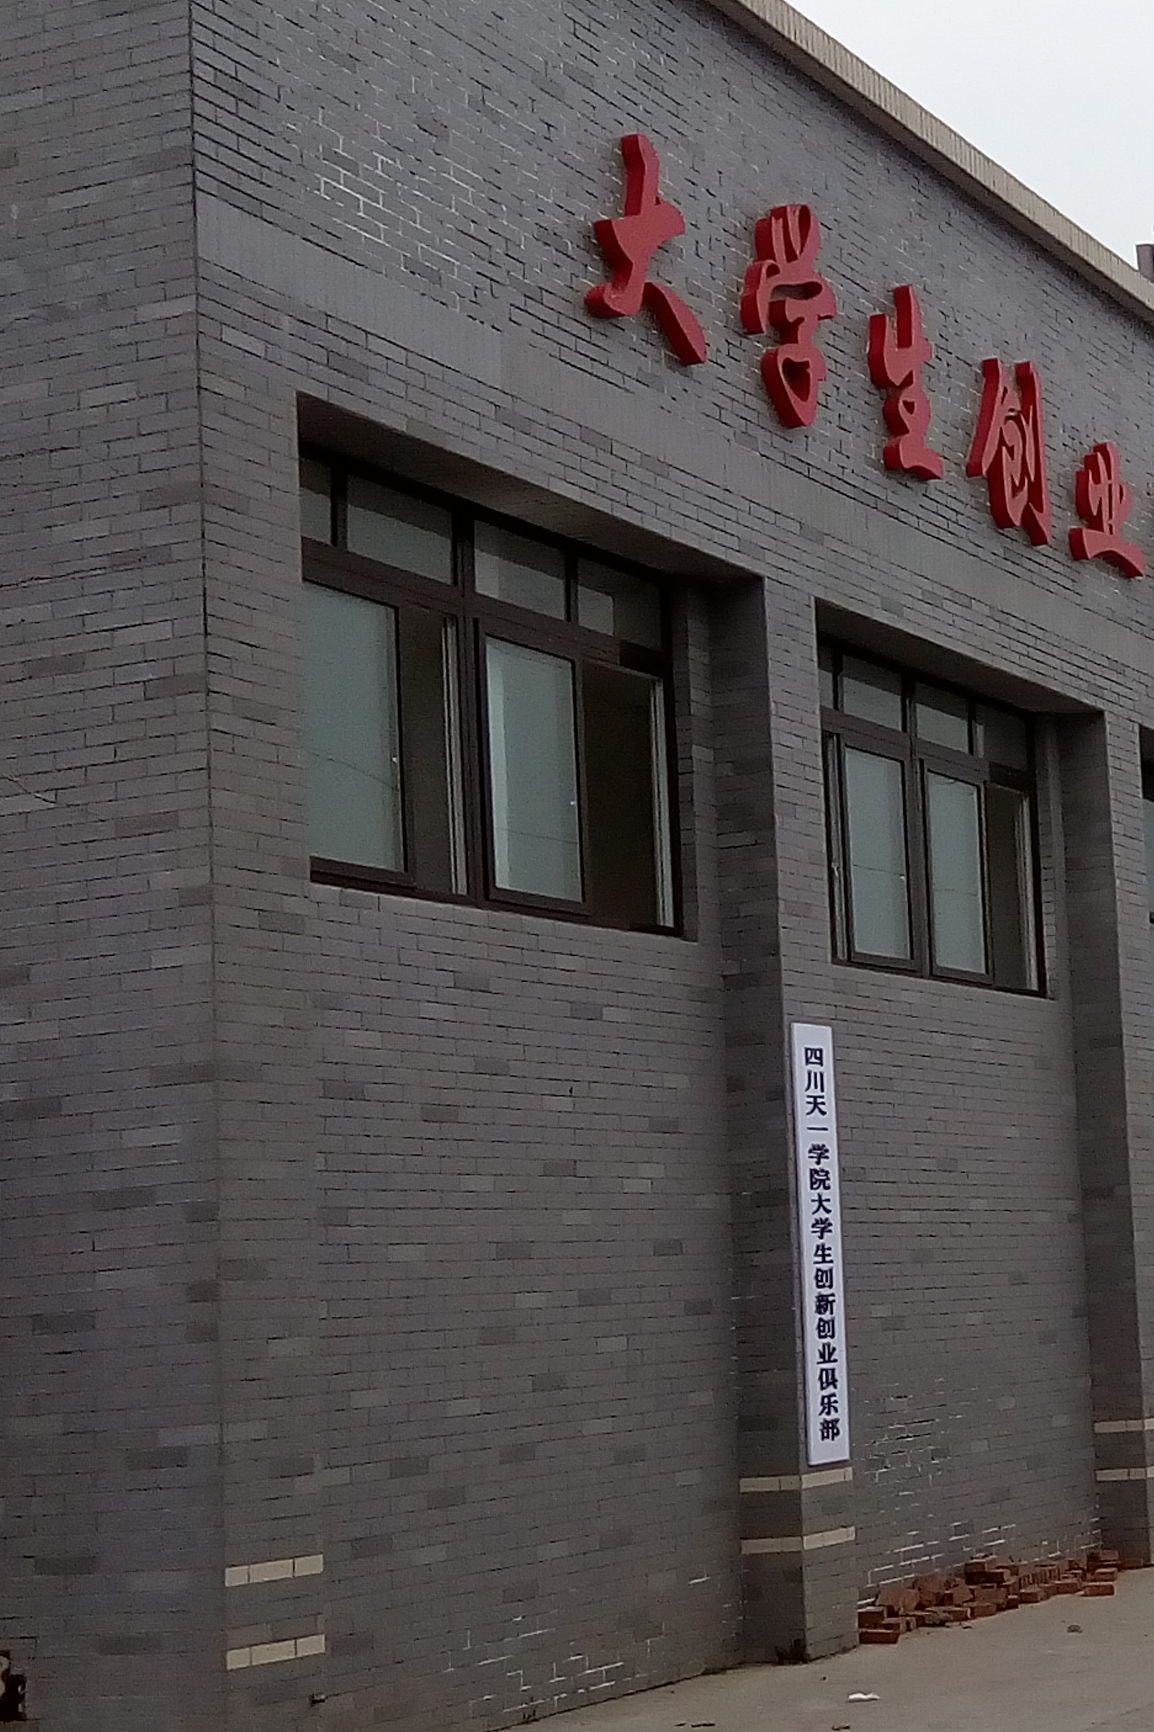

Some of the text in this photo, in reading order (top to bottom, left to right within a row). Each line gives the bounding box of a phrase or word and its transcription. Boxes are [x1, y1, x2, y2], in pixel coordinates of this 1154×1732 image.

[804, 1046, 840, 1442] 四川天一学院大学生创新创业俱乐部
